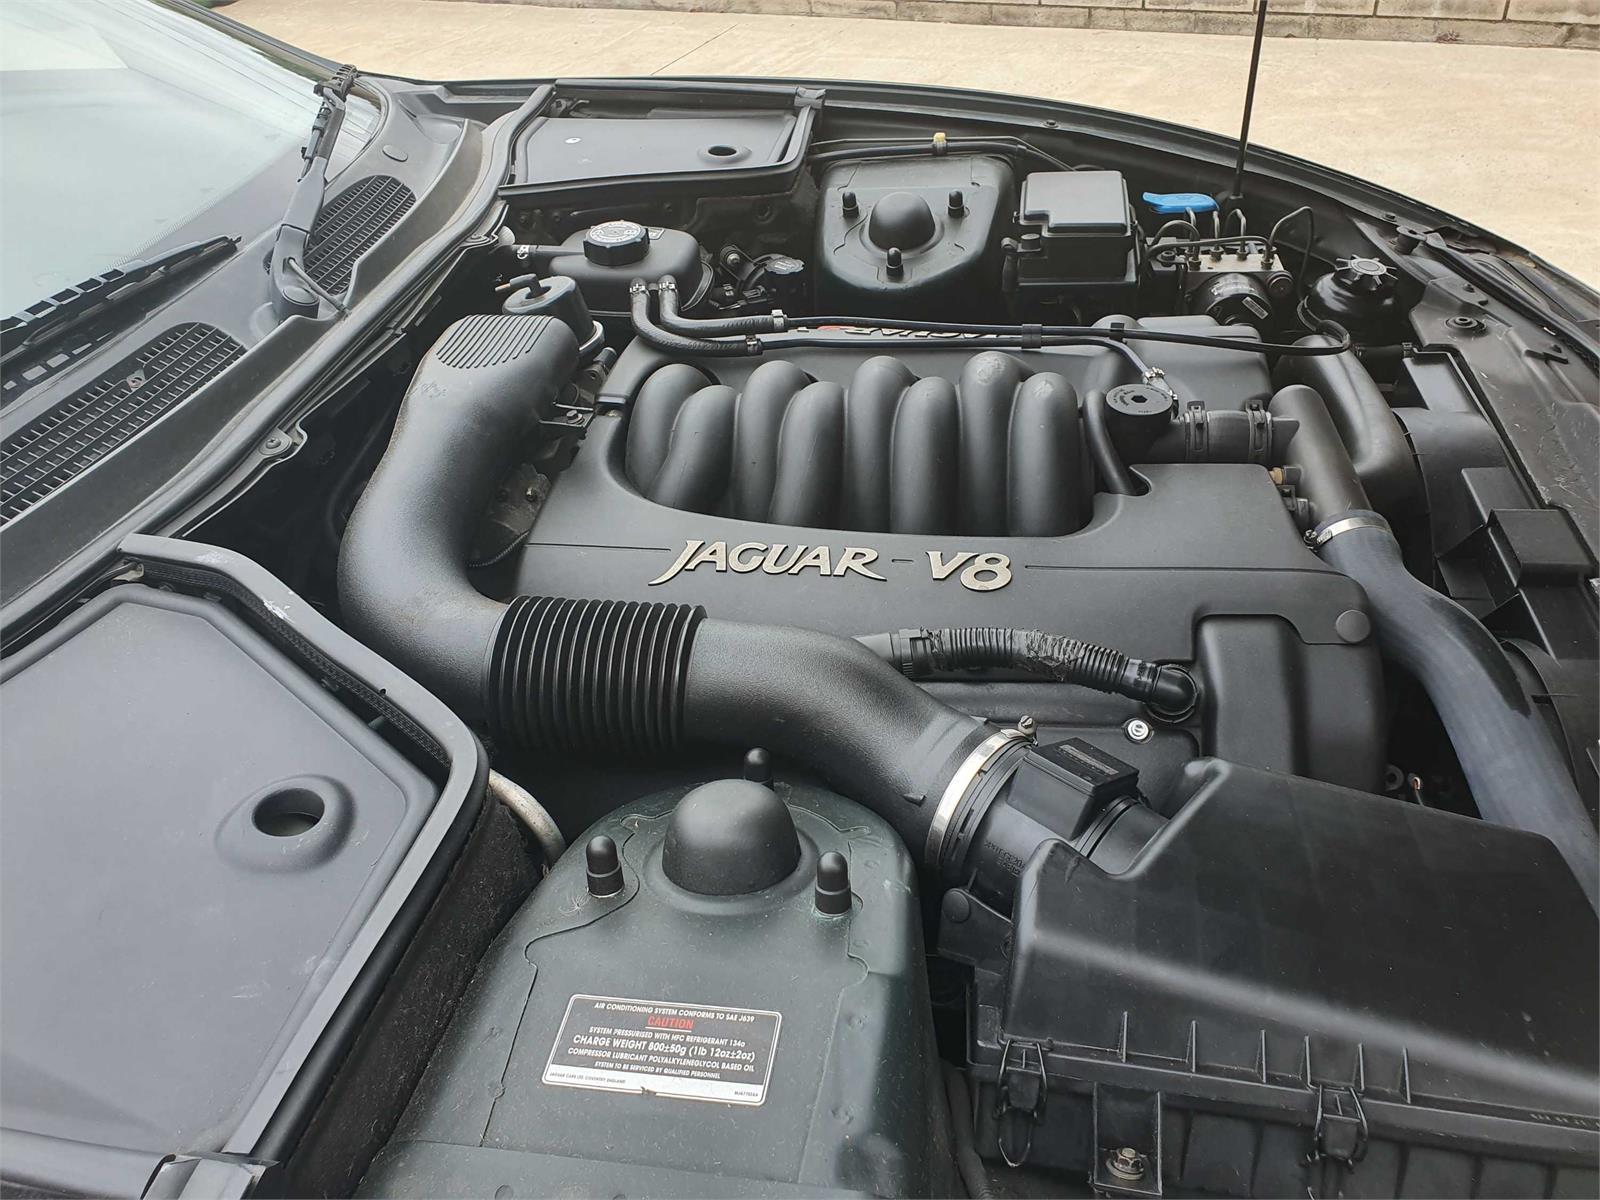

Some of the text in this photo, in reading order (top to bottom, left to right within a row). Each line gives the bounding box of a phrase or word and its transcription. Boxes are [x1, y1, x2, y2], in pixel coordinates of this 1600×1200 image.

[648, 540, 1013, 592] JAGUAR V8
[594, 1002, 755, 1022] AIR CONDITIONING SYSTEM CONFORMS TO SAE J639
[648, 1016, 695, 1029] CAUTION
[589, 1026, 612, 1034] SYSTEM
[612, 1028, 653, 1039] PRESSURISED
[654, 1031, 670, 1040] WITH
[671, 1033, 685, 1042] HFC
[686, 1035, 728, 1046] REFRIGERANT
[573, 1034, 611, 1047] CHARGE
[612, 1038, 648, 1051] WEIGHT
[648, 1042, 687, 1055] 800±50g
[710, 1047, 755, 1063] 12oz±2oz)
[568, 1047, 755, 1072] COMPRESSOR LUBRICANT POLYALKYLENEGLYCOL BASED OIL
[594, 1061, 614, 1069] SYSTEM
[630, 1064, 655, 1073] SERVICED
[663, 1067, 690, 1076] QUALIFIED
[690, 1070, 721, 1079] PERSONNEL
